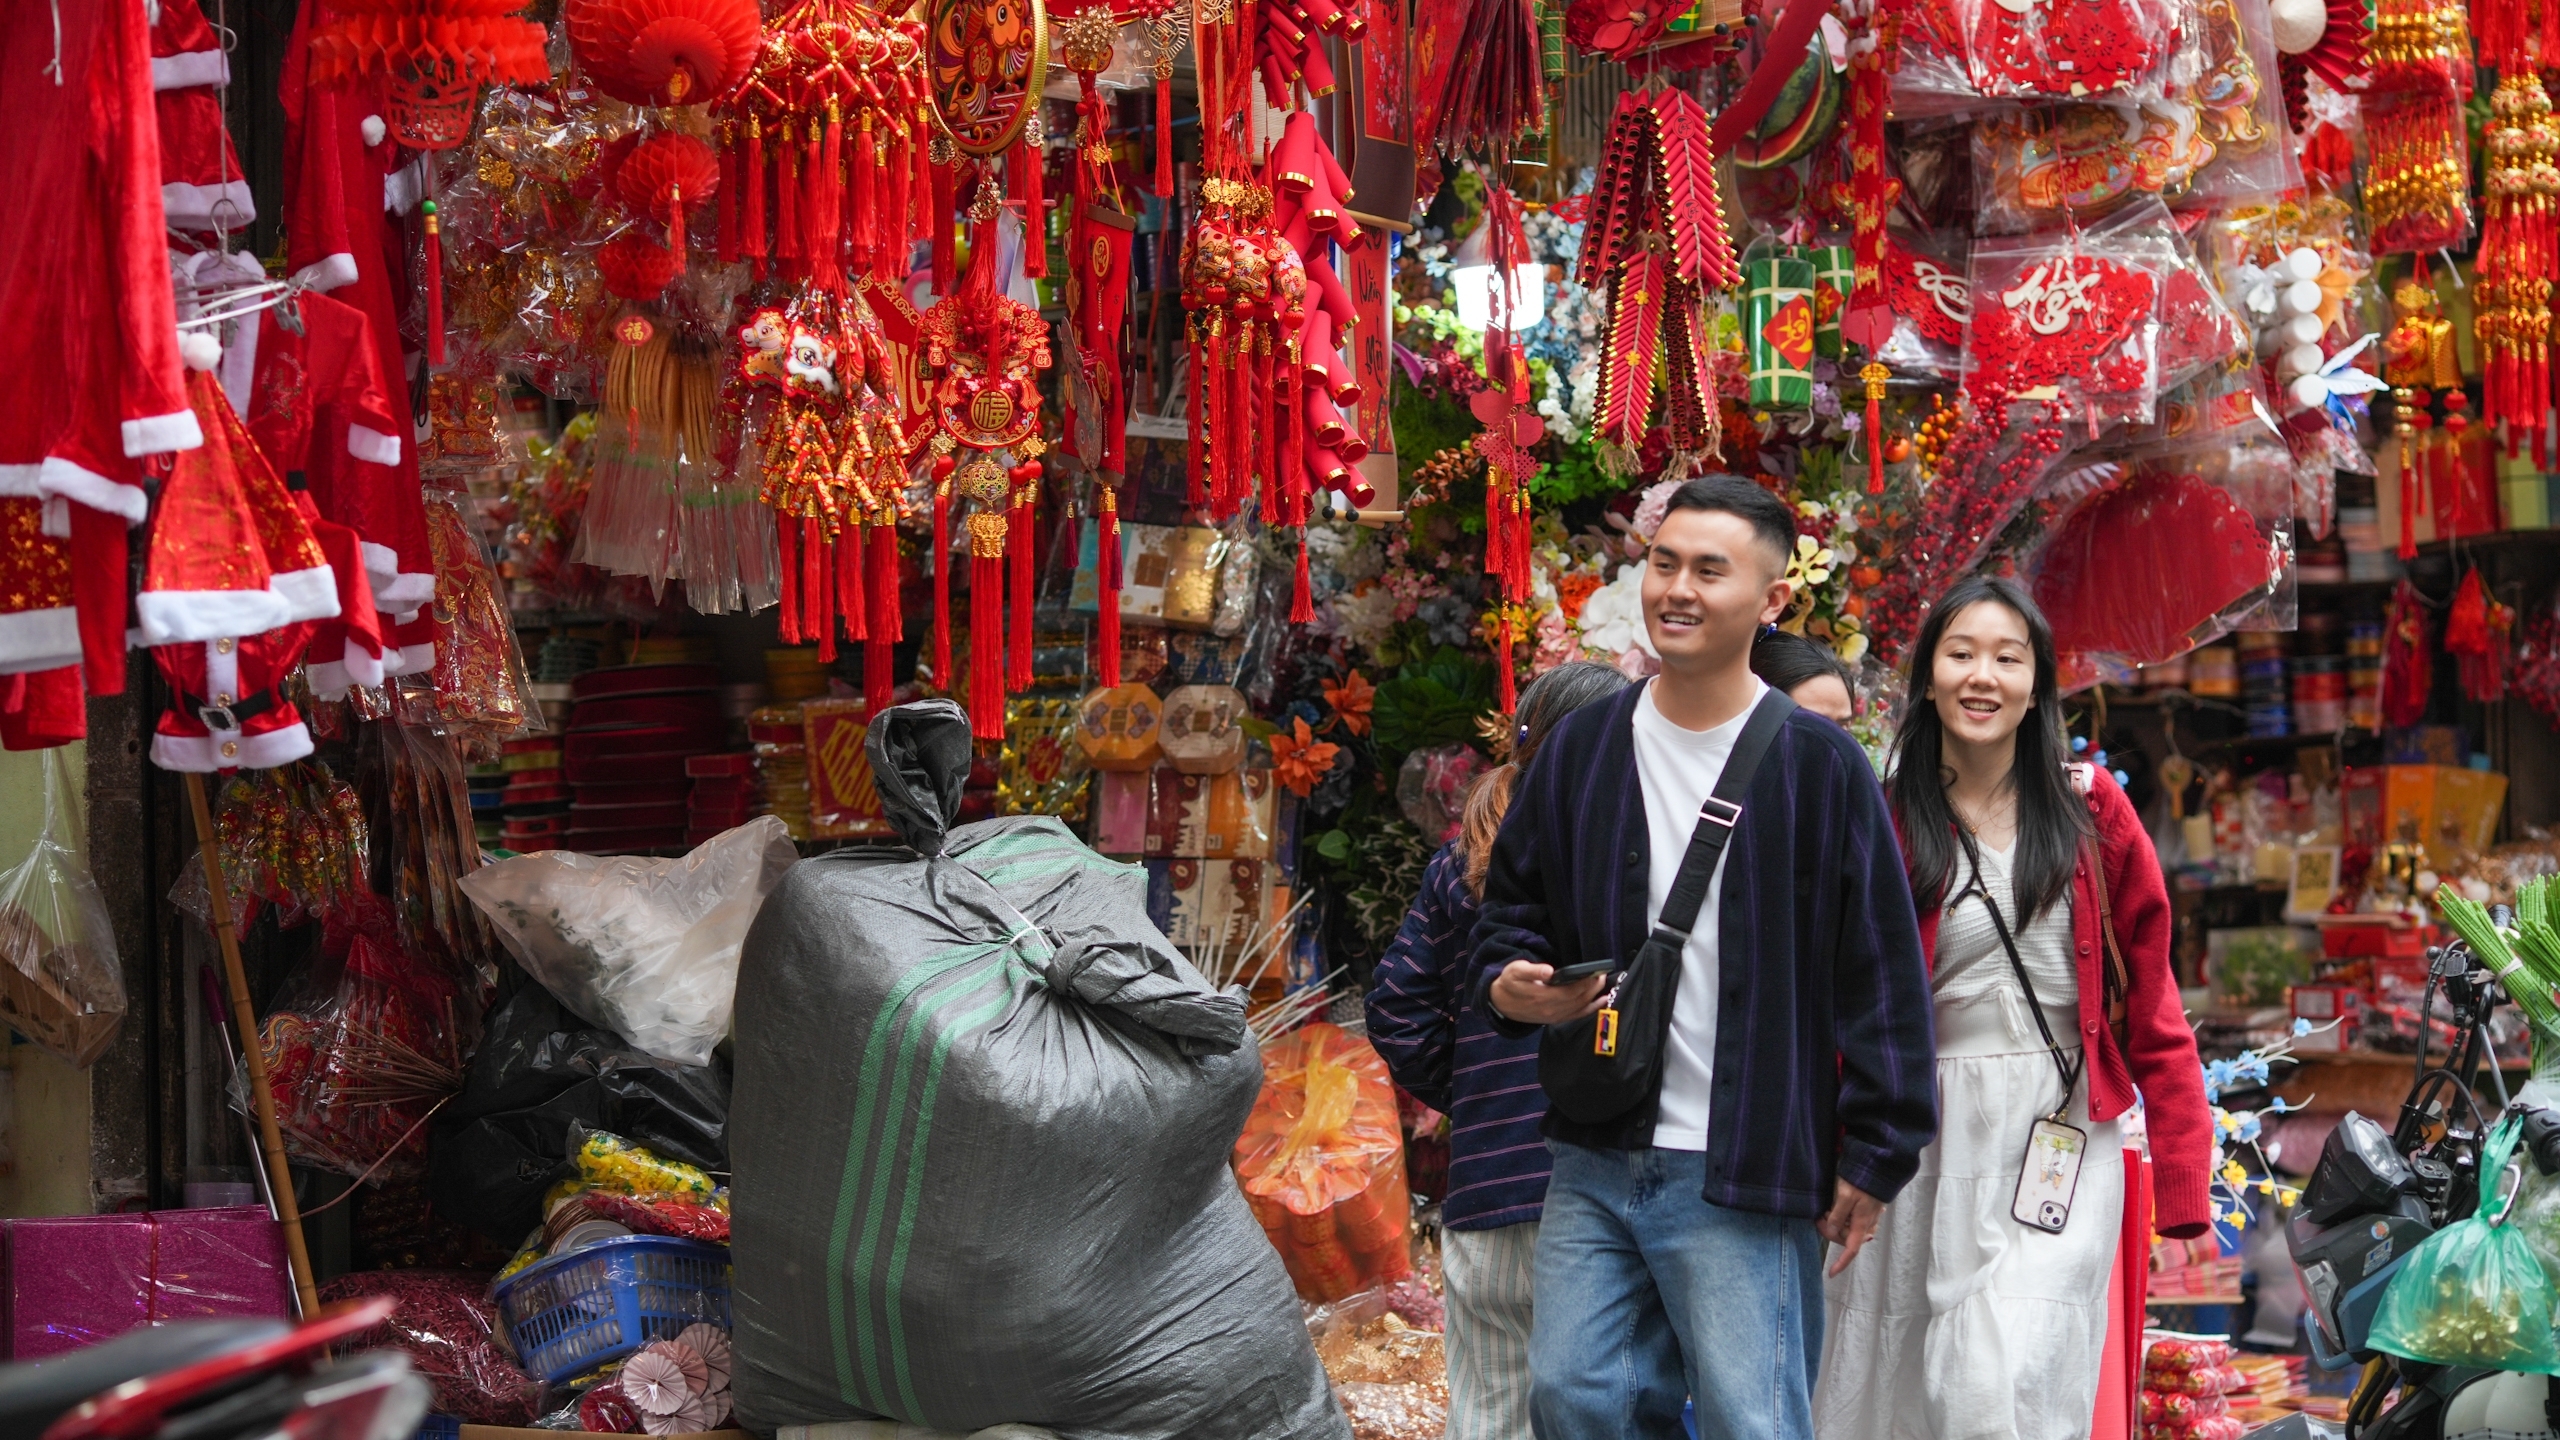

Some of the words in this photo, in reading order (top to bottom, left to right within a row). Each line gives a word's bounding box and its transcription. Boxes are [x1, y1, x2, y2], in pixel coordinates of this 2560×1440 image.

[1358, 259, 1382, 306] Năm
[2003, 258, 2101, 335] Tết
[623, 321, 644, 341] 福
[974, 391, 1010, 429] 福
